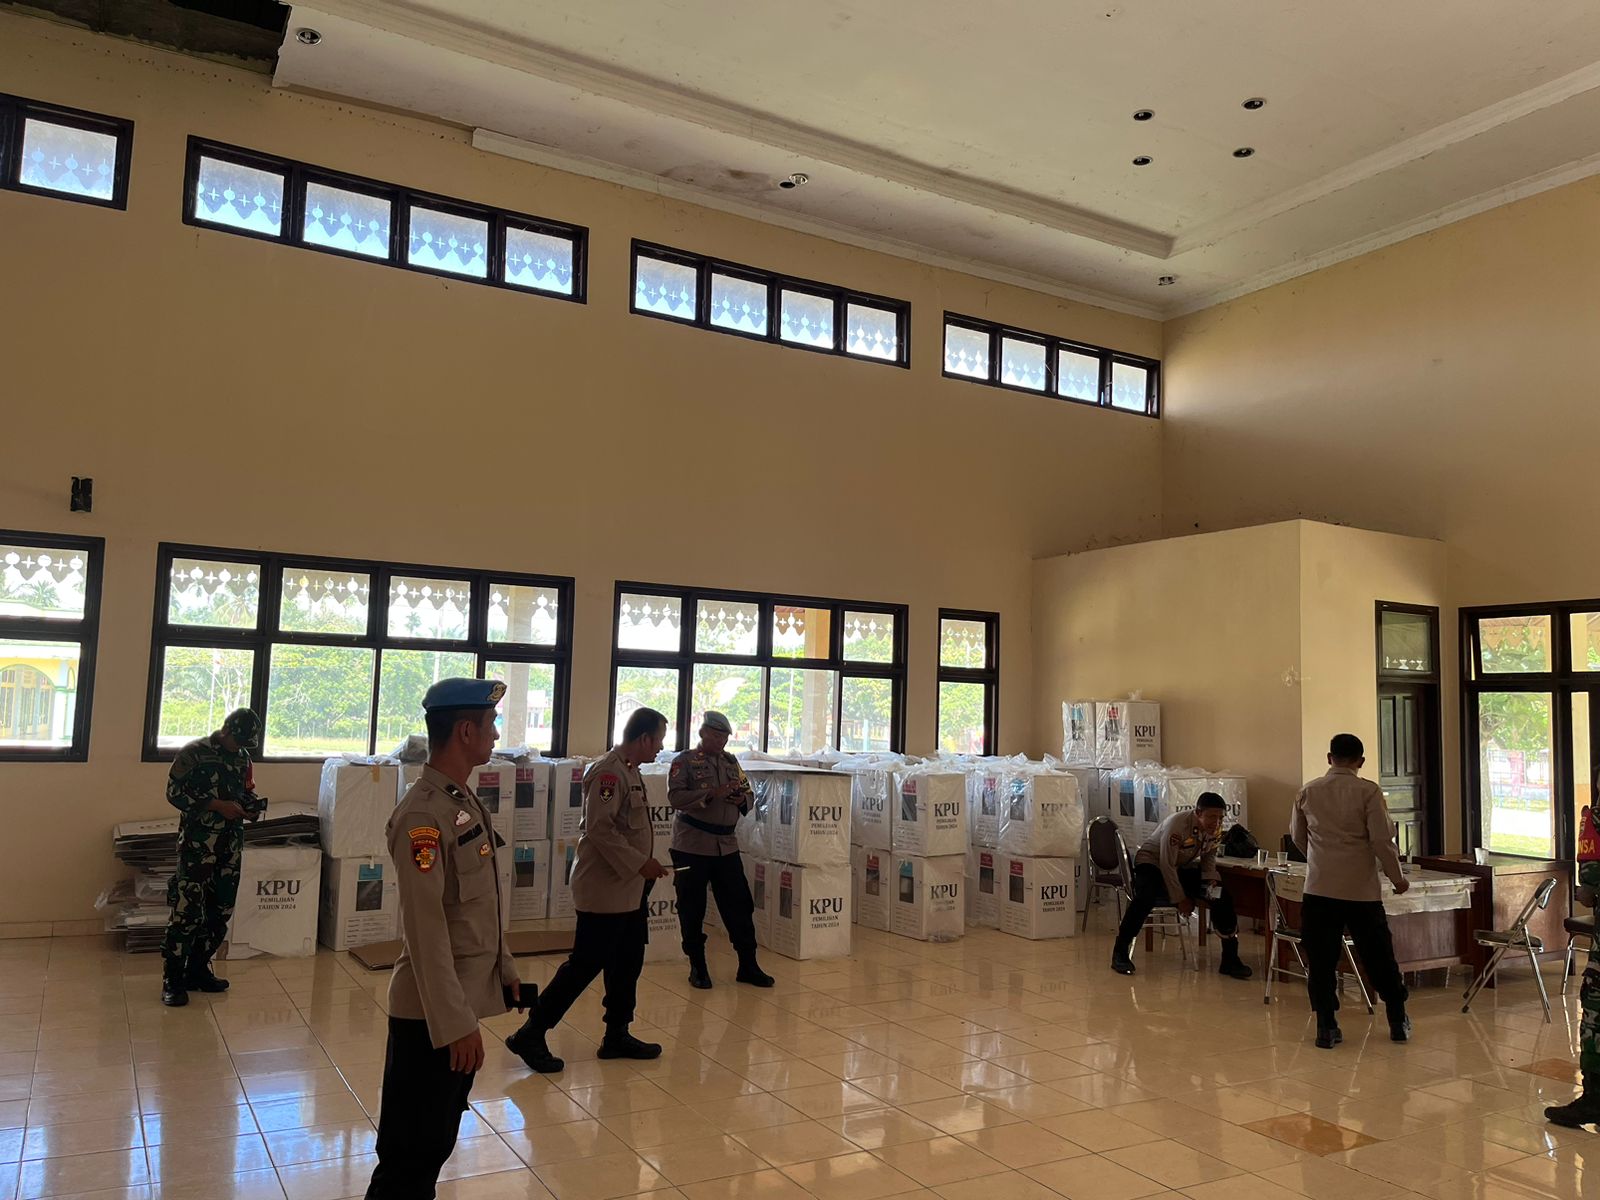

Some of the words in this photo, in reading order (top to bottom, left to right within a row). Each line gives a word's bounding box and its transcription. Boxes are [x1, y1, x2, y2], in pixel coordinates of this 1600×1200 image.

[1134, 725, 1156, 738] KPU
[862, 797, 884, 811] KPU
[934, 802, 960, 817] KPU
[808, 806, 843, 822] KPU
[255, 880, 301, 896] KPU
[930, 883, 958, 899] KPU
[1041, 885, 1068, 900] KPU
[809, 897, 843, 914] KPU
